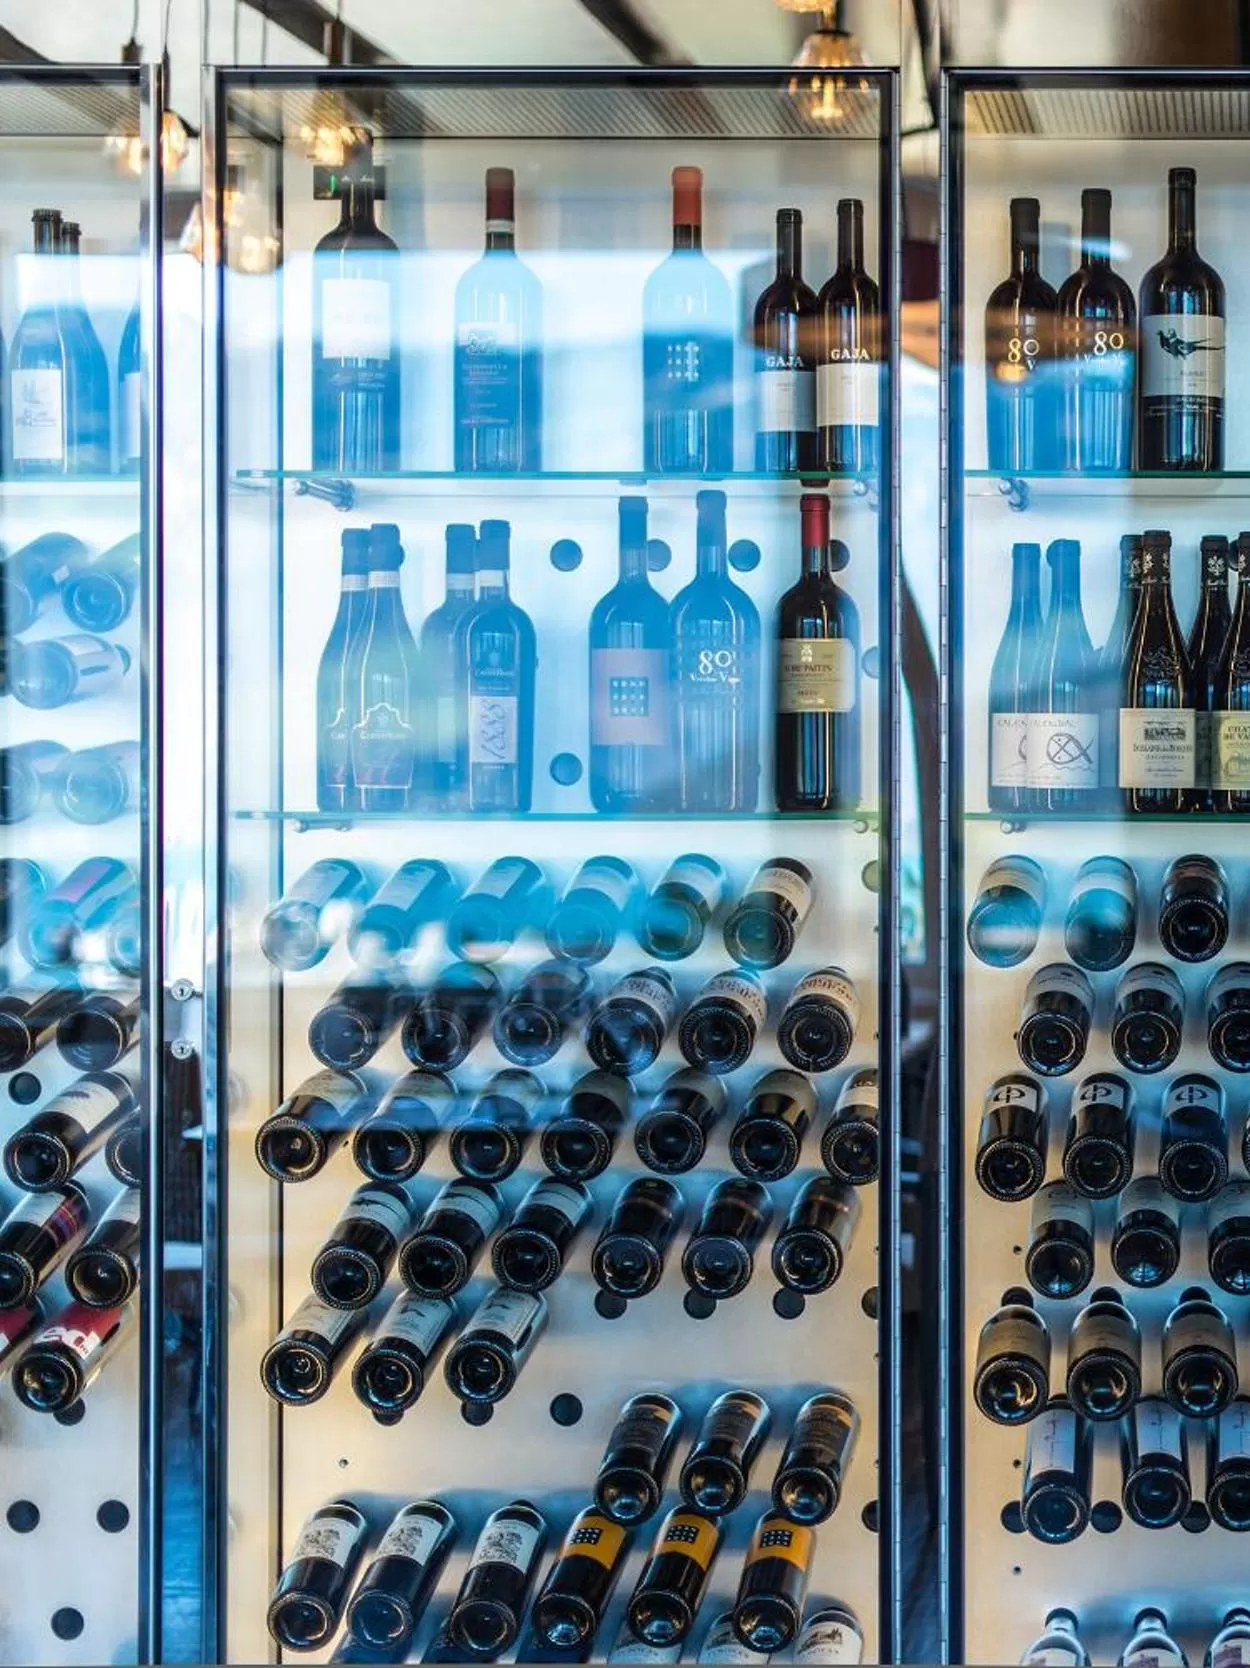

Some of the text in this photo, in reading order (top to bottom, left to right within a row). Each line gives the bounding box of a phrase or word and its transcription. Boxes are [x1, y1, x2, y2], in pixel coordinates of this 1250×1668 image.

[831, 348, 870, 361] GAJA
[1008, 338, 1040, 362] 80
[1093, 331, 1124, 355] 80
[765, 356, 804, 368] GAJA
[699, 650, 732, 675] 80
